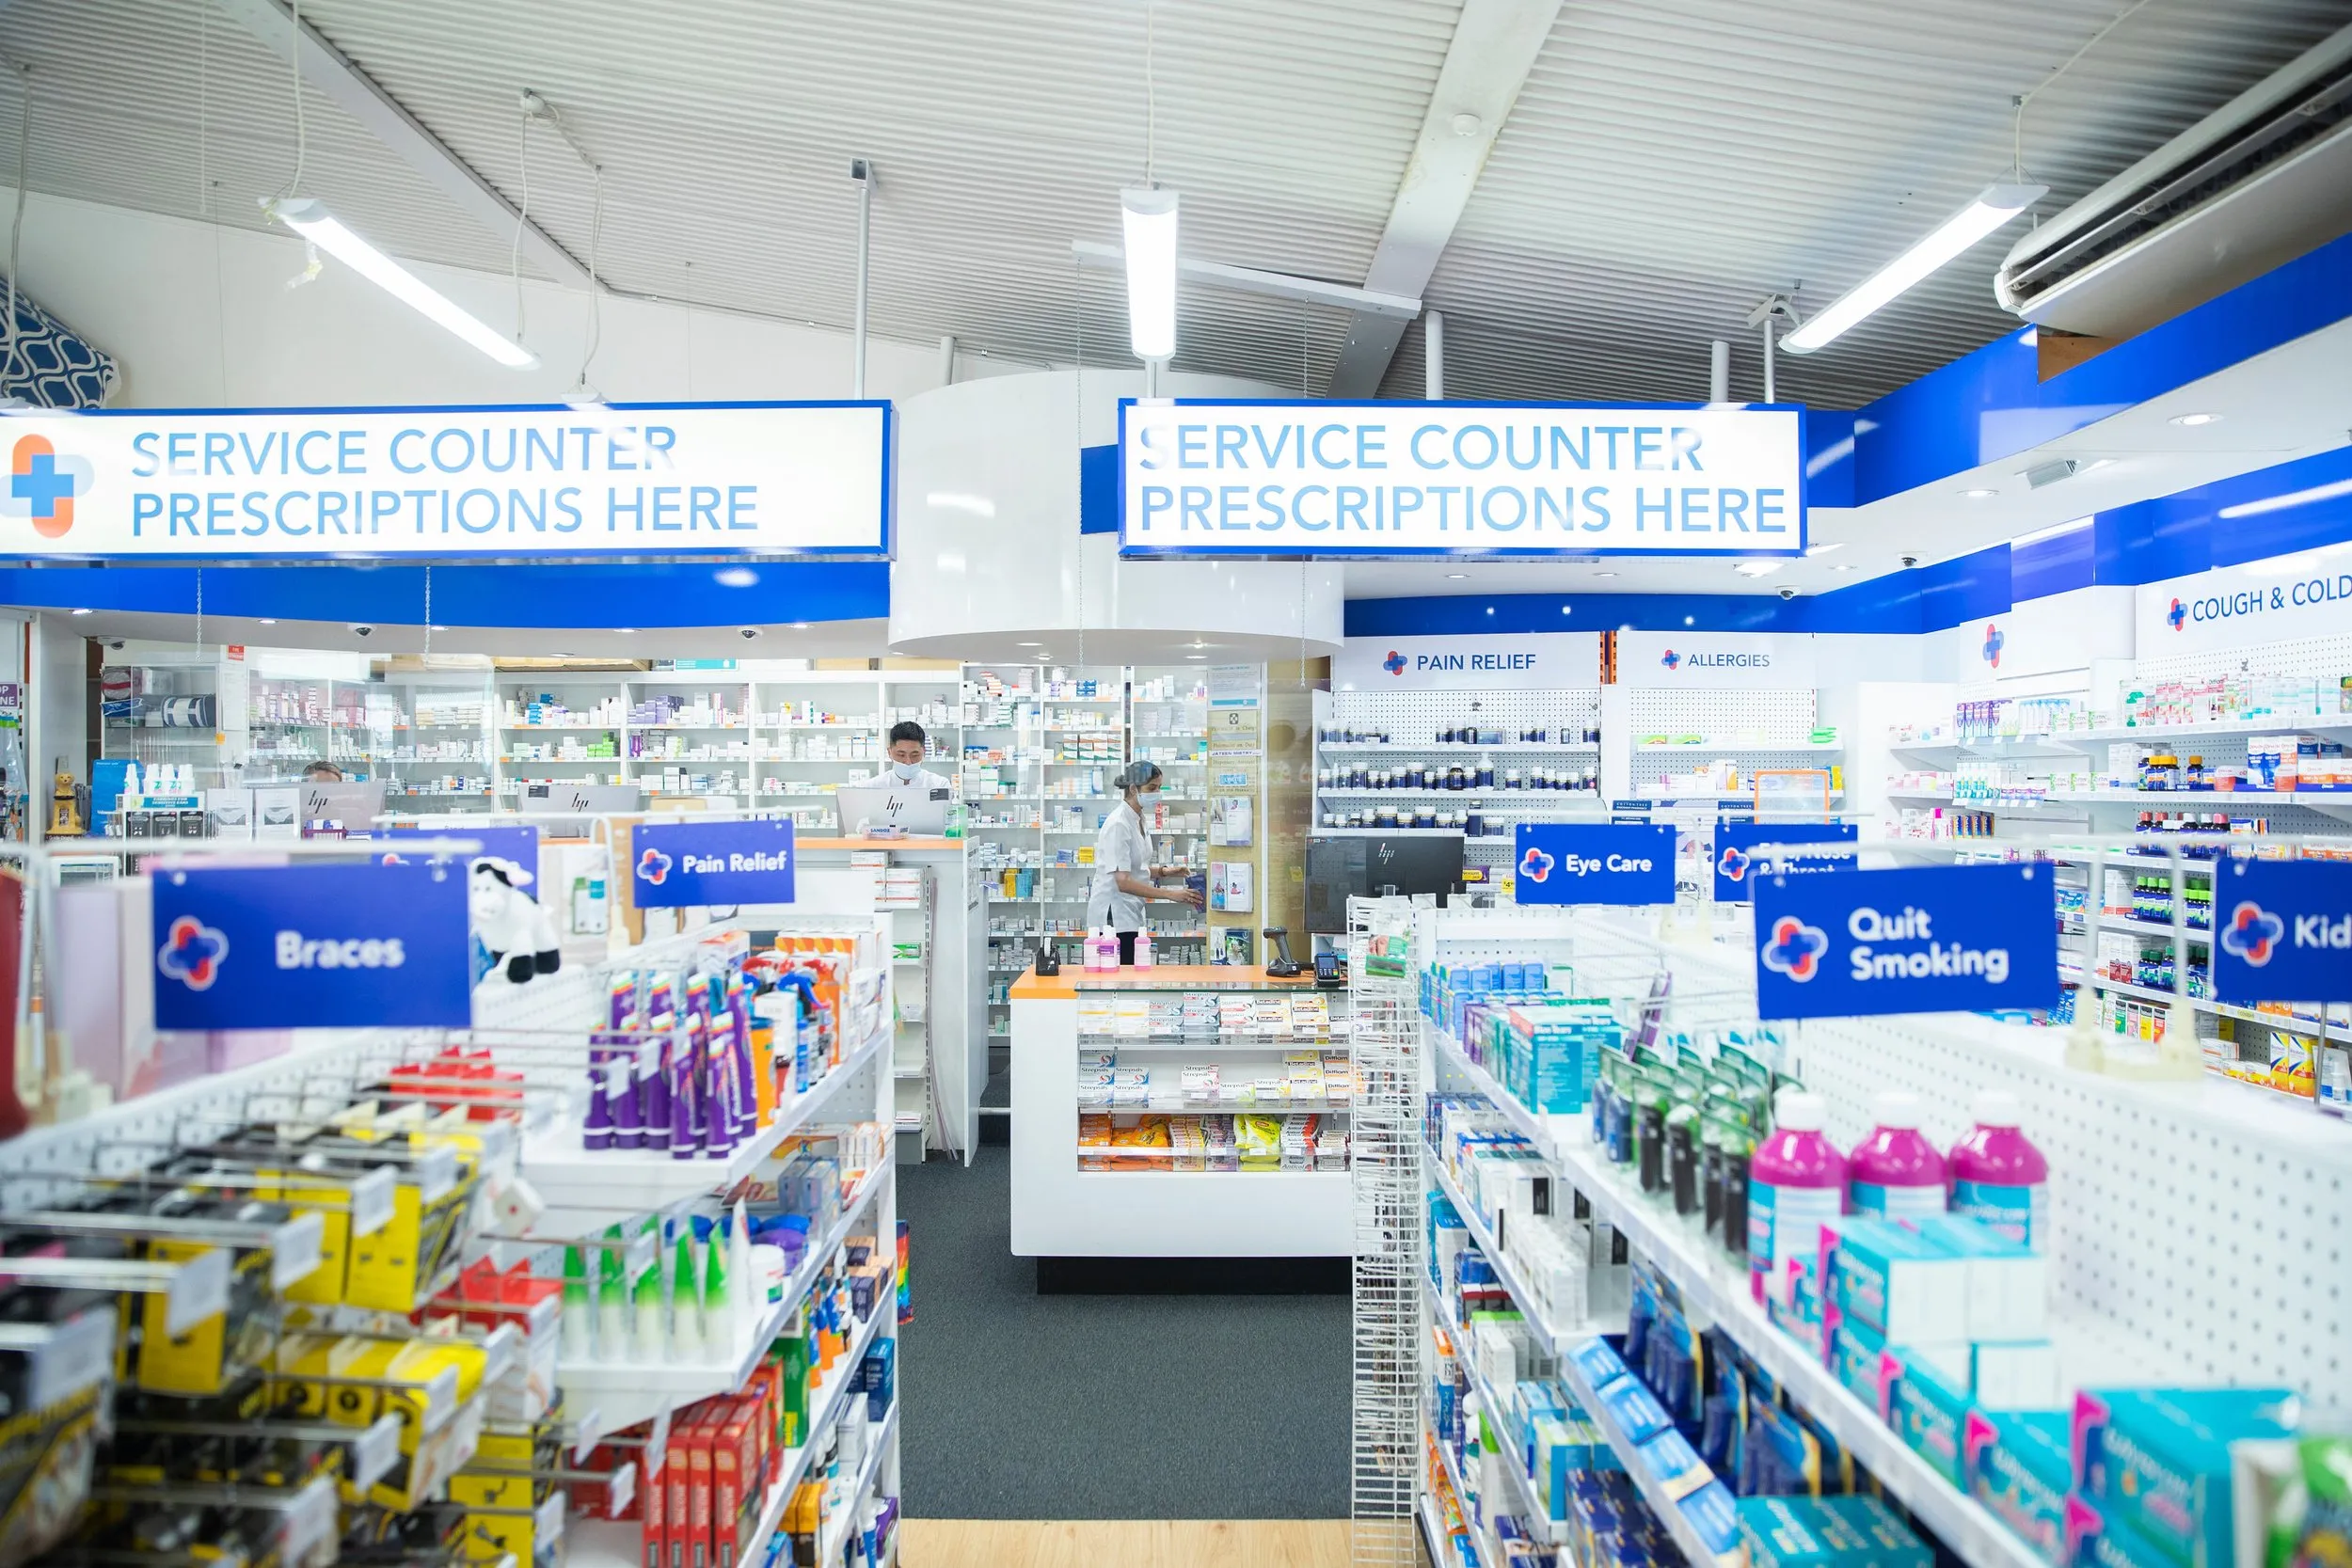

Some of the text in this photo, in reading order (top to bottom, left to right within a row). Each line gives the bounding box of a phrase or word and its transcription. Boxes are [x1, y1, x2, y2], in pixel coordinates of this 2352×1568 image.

[132, 426, 675, 477] SERVICE COUNTER
[1139, 423, 1704, 470] SERVICE COUNTER
[133, 485, 758, 536] PRESCRIPTIONS HERE
[1141, 484, 1786, 532] PRESCRIPTIONS HERE
[2193, 575, 2352, 622] COUGH & COLD
[1417, 654, 1536, 671] PAIN RELIEF
[1688, 654, 1771, 667] ALLERGIES
[682, 850, 787, 874] Pain Relief
[1565, 854, 1652, 877] Eye Care
[1848, 906, 1932, 942] Quit
[275, 930, 405, 970] Braces
[1850, 942, 2010, 984] Smoking
